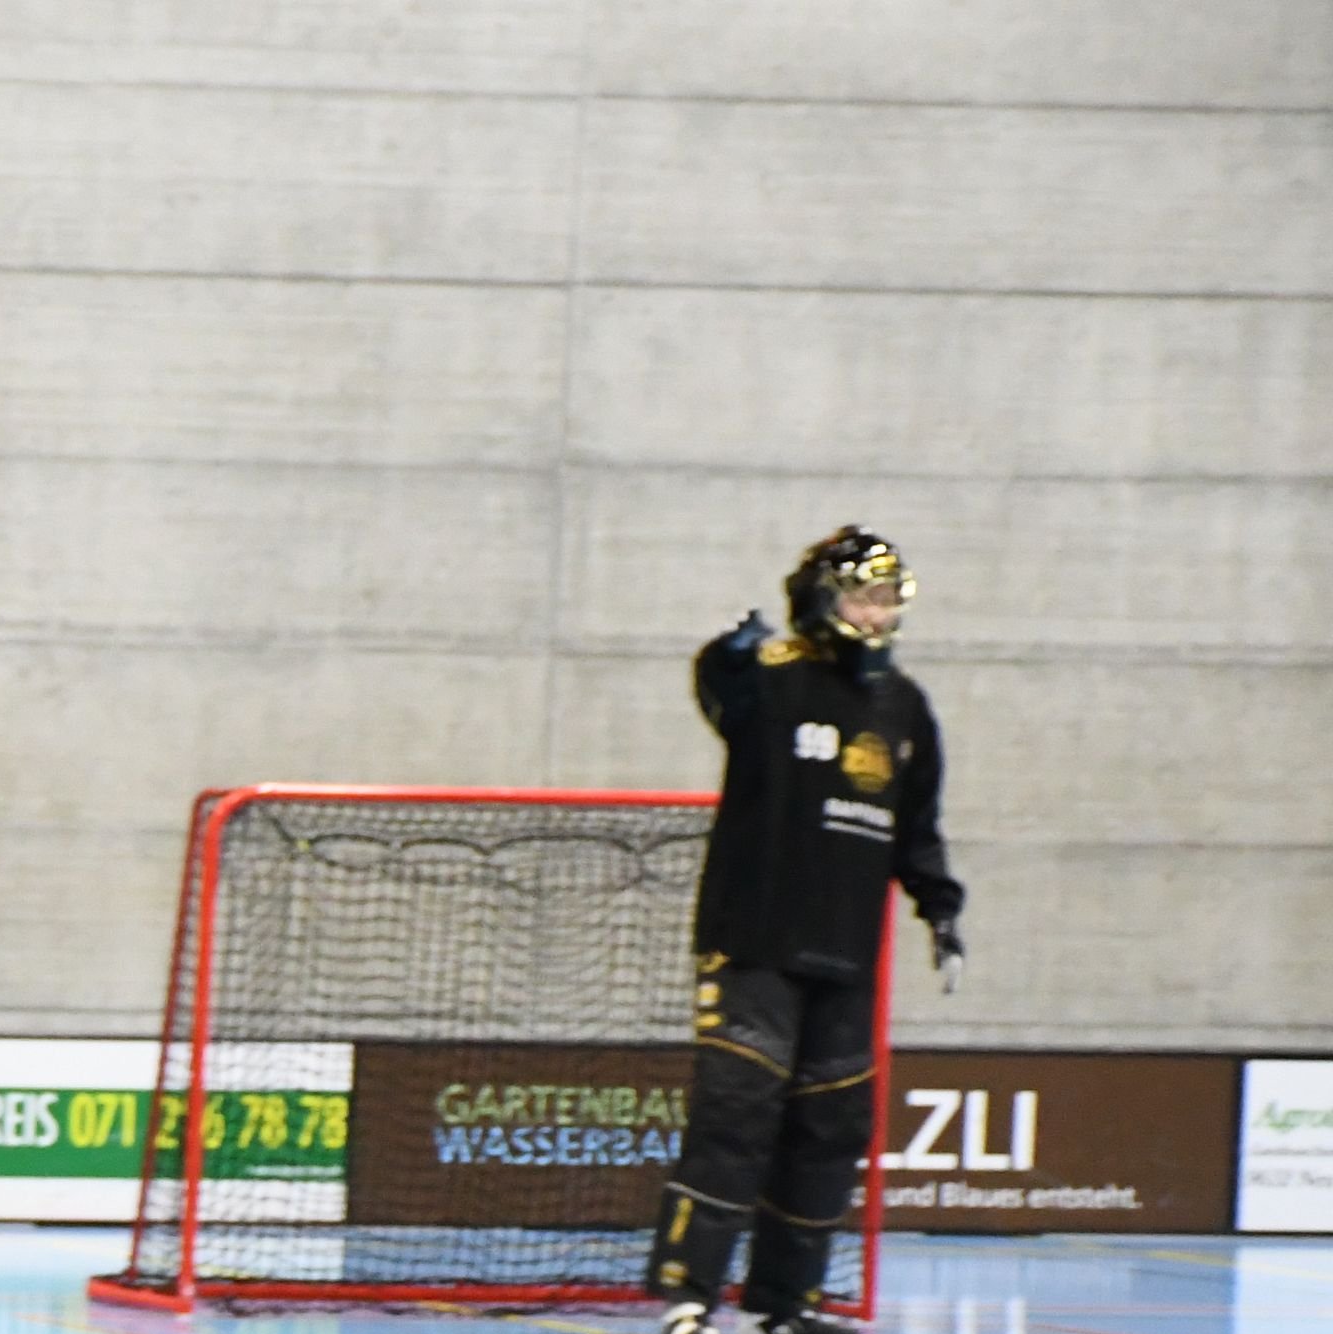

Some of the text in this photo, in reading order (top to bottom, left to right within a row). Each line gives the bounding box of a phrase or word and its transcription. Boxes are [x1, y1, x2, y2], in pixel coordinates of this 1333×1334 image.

[67, 1092, 137, 1147] 071
[153, 1094, 226, 1149] 26
[237, 1094, 288, 1149] 78
[297, 1094, 349, 1149] 78
